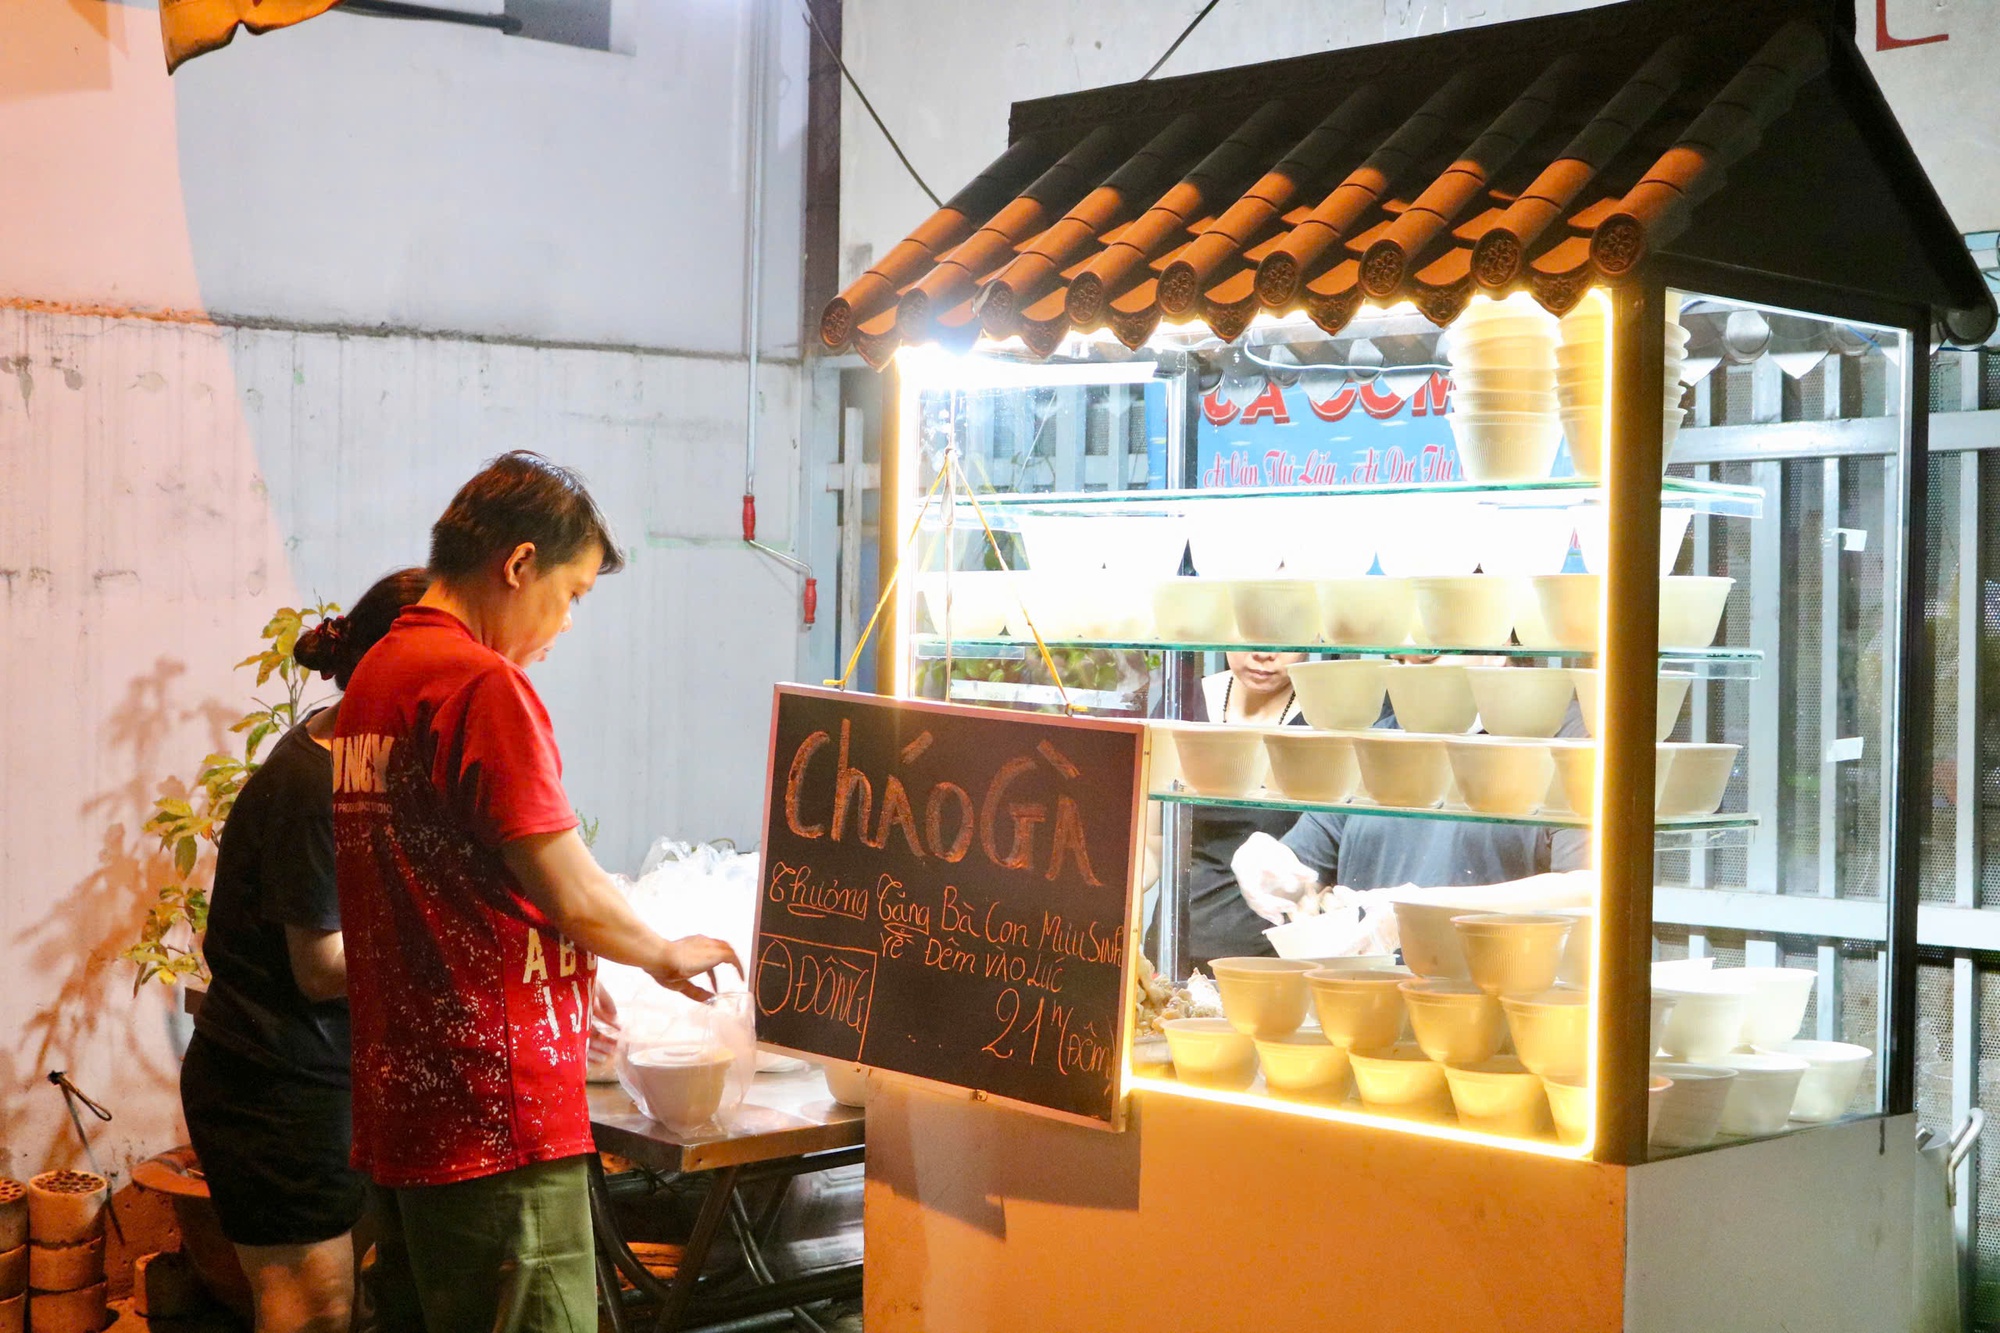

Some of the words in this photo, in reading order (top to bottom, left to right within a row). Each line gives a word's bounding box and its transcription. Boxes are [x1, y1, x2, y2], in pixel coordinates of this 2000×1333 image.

[1352, 447, 1379, 483] Ai
[941, 886, 982, 938] Bà
[985, 901, 1030, 948] Con
[925, 936, 975, 974] Đêm
